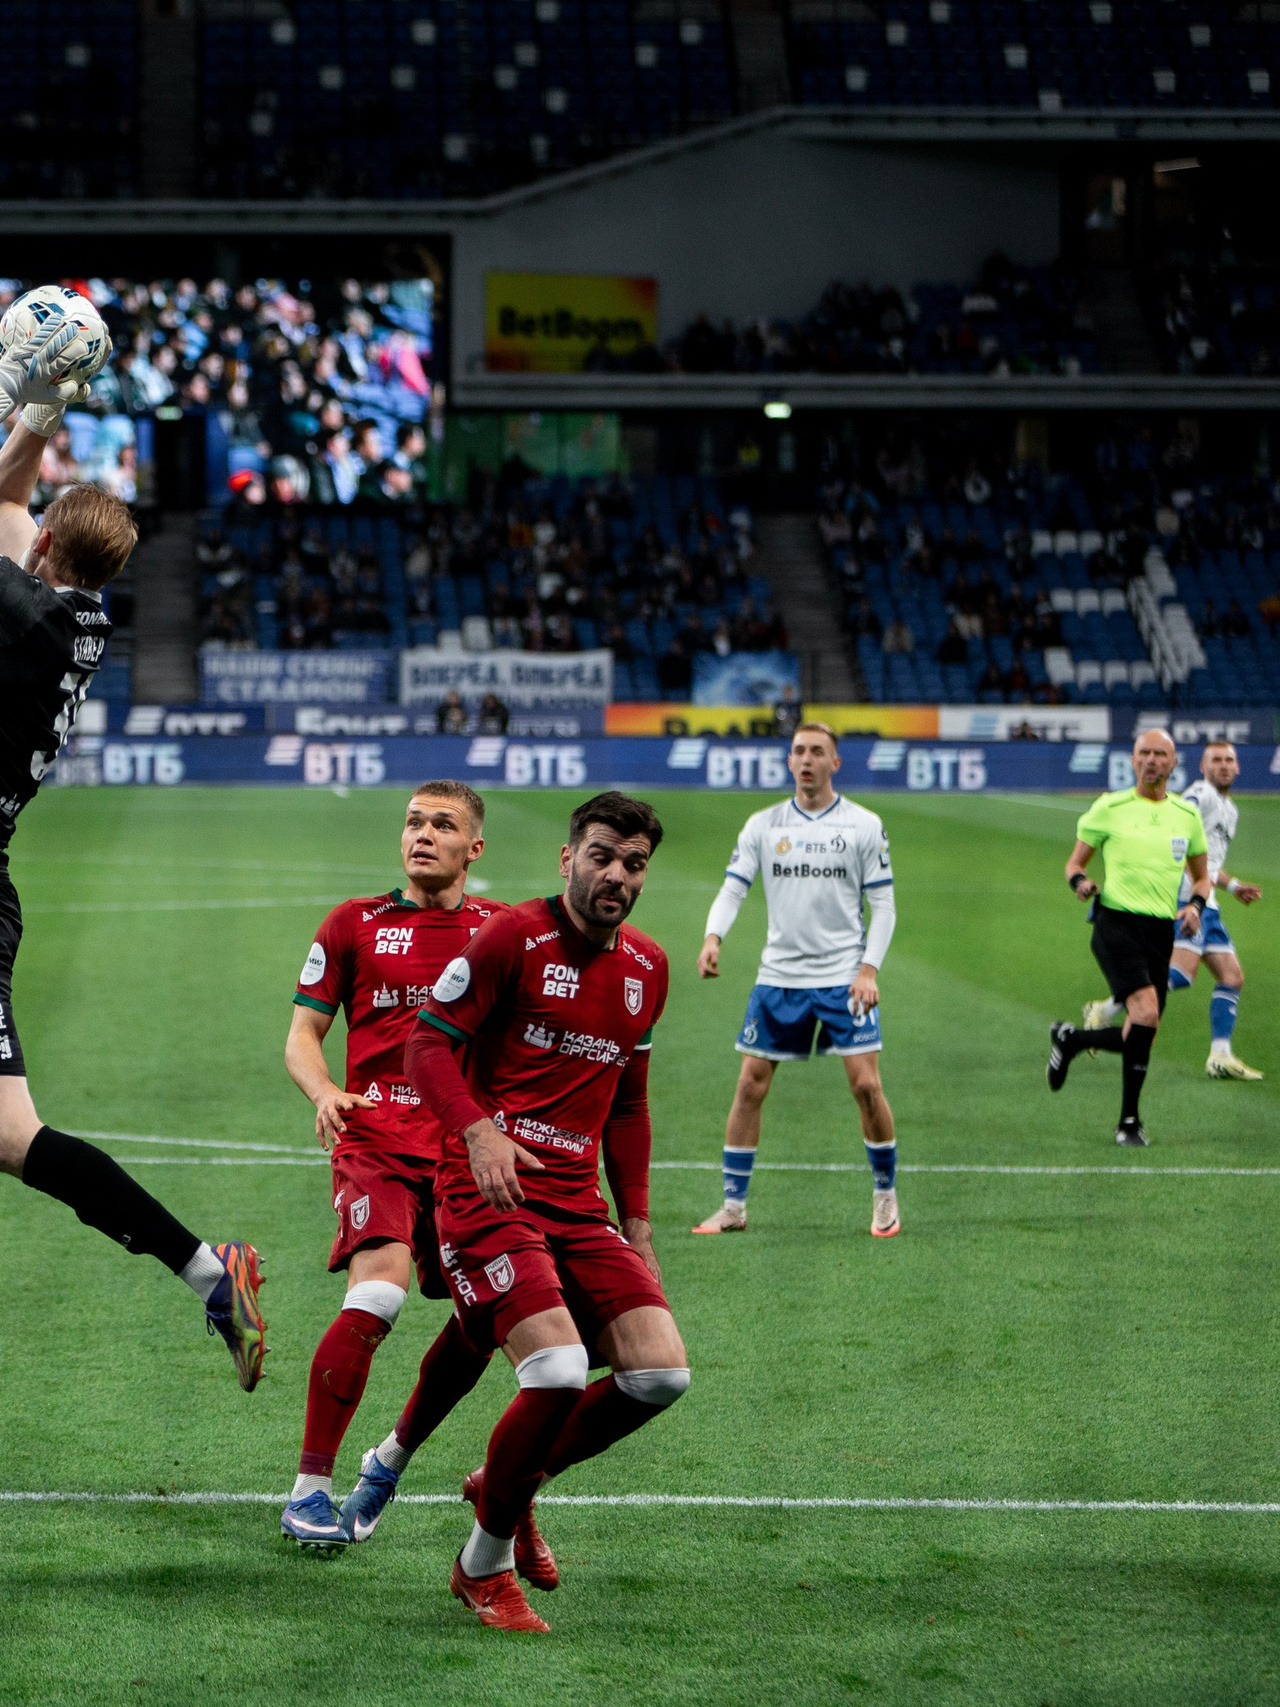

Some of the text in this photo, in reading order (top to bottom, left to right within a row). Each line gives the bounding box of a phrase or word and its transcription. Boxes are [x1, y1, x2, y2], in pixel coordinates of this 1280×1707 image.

[103, 744, 185, 784] ВТБ
[303, 745, 386, 785] ВТБ
[505, 745, 587, 787] ВТБ
[706, 747, 787, 788] ВТБ
[906, 749, 988, 790] ВТБ
[805, 843, 827, 853] ВТБ
[772, 863, 847, 878] BetBoom
[372, 901, 398, 917] НКН
[375, 927, 413, 941] FON
[536, 929, 562, 944] НКНХ
[375, 940, 413, 955] BET
[542, 963, 580, 983] FON
[542, 979, 580, 999] BET
[562, 1030, 620, 1054] КАЗАНЬ
[513, 1125, 585, 1155] НЕФТЕХИМ
